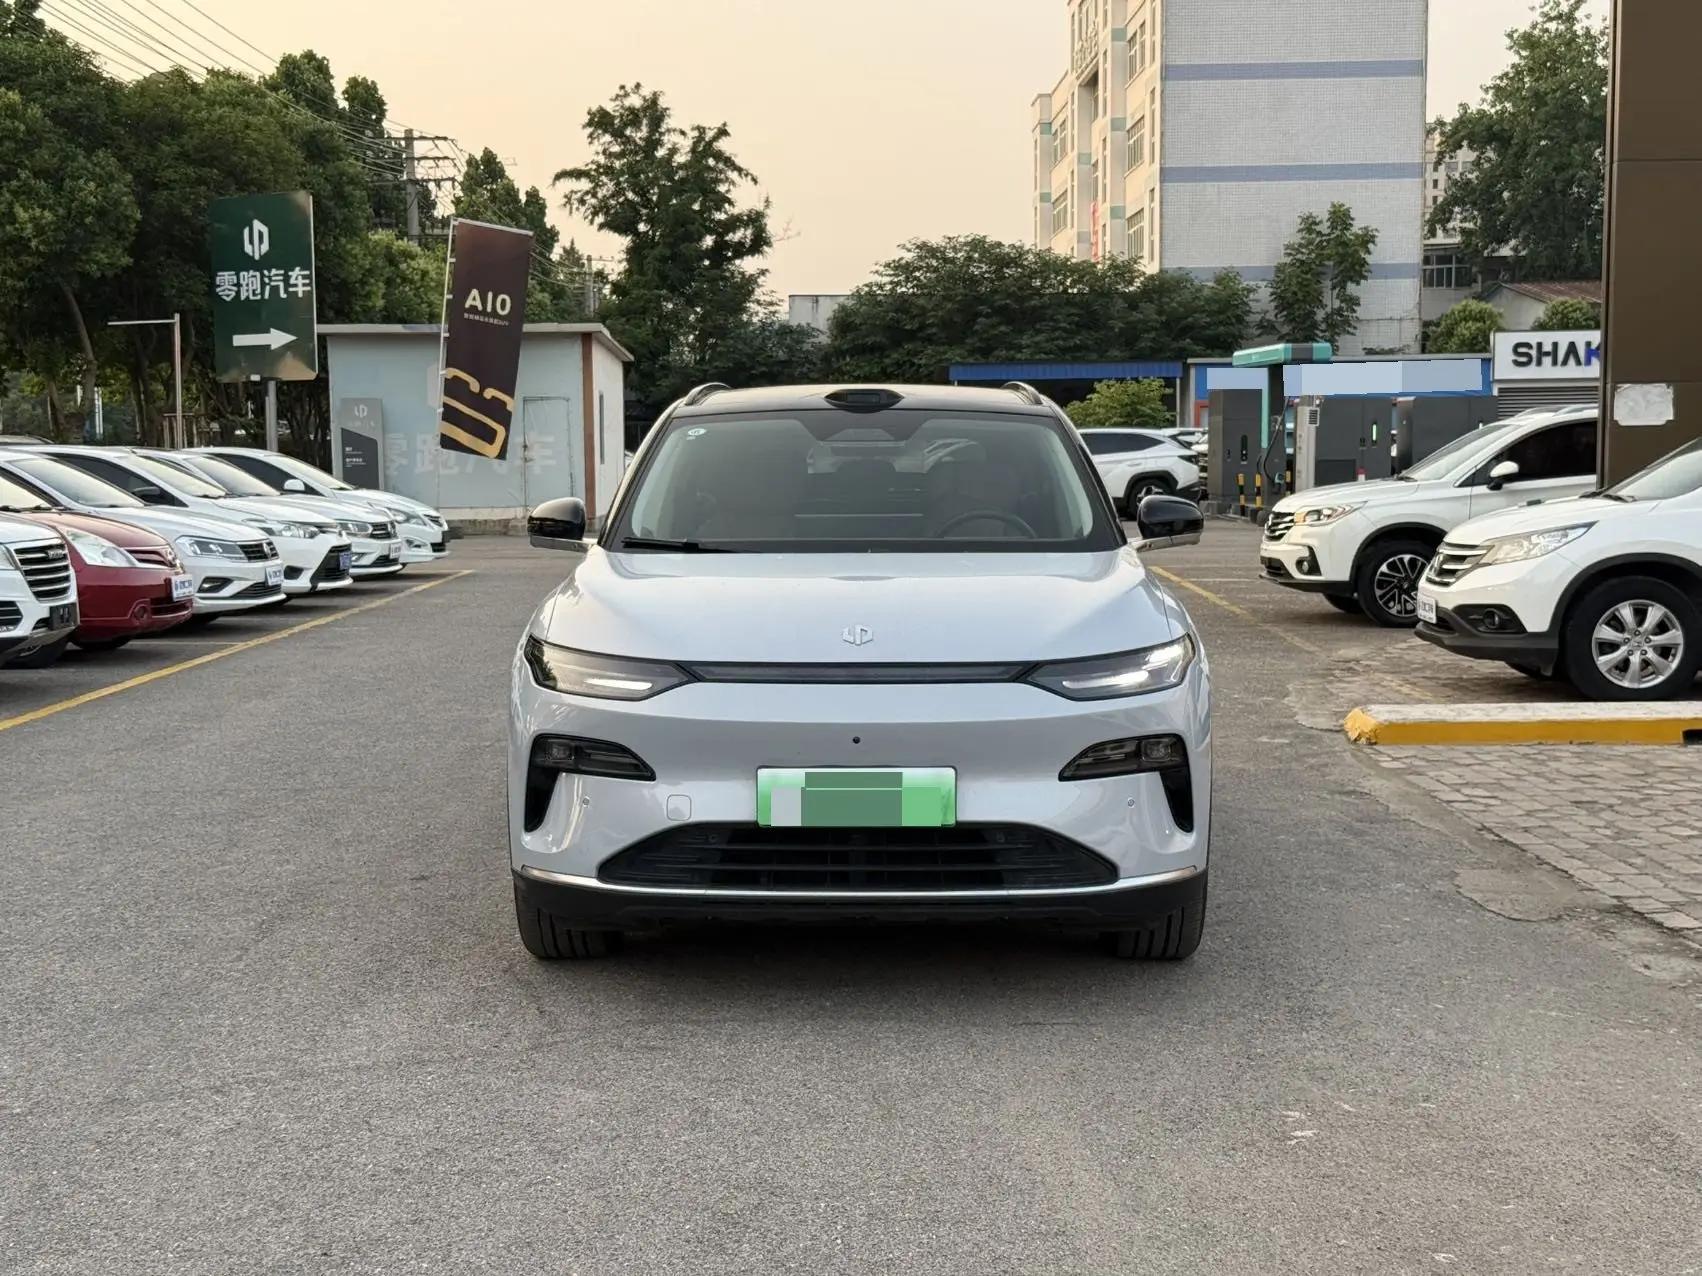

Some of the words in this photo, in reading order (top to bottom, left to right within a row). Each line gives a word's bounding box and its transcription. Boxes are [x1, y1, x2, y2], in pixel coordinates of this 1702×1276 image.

[215, 267, 312, 301] 零跑汽车
[464, 288, 512, 316] A10
